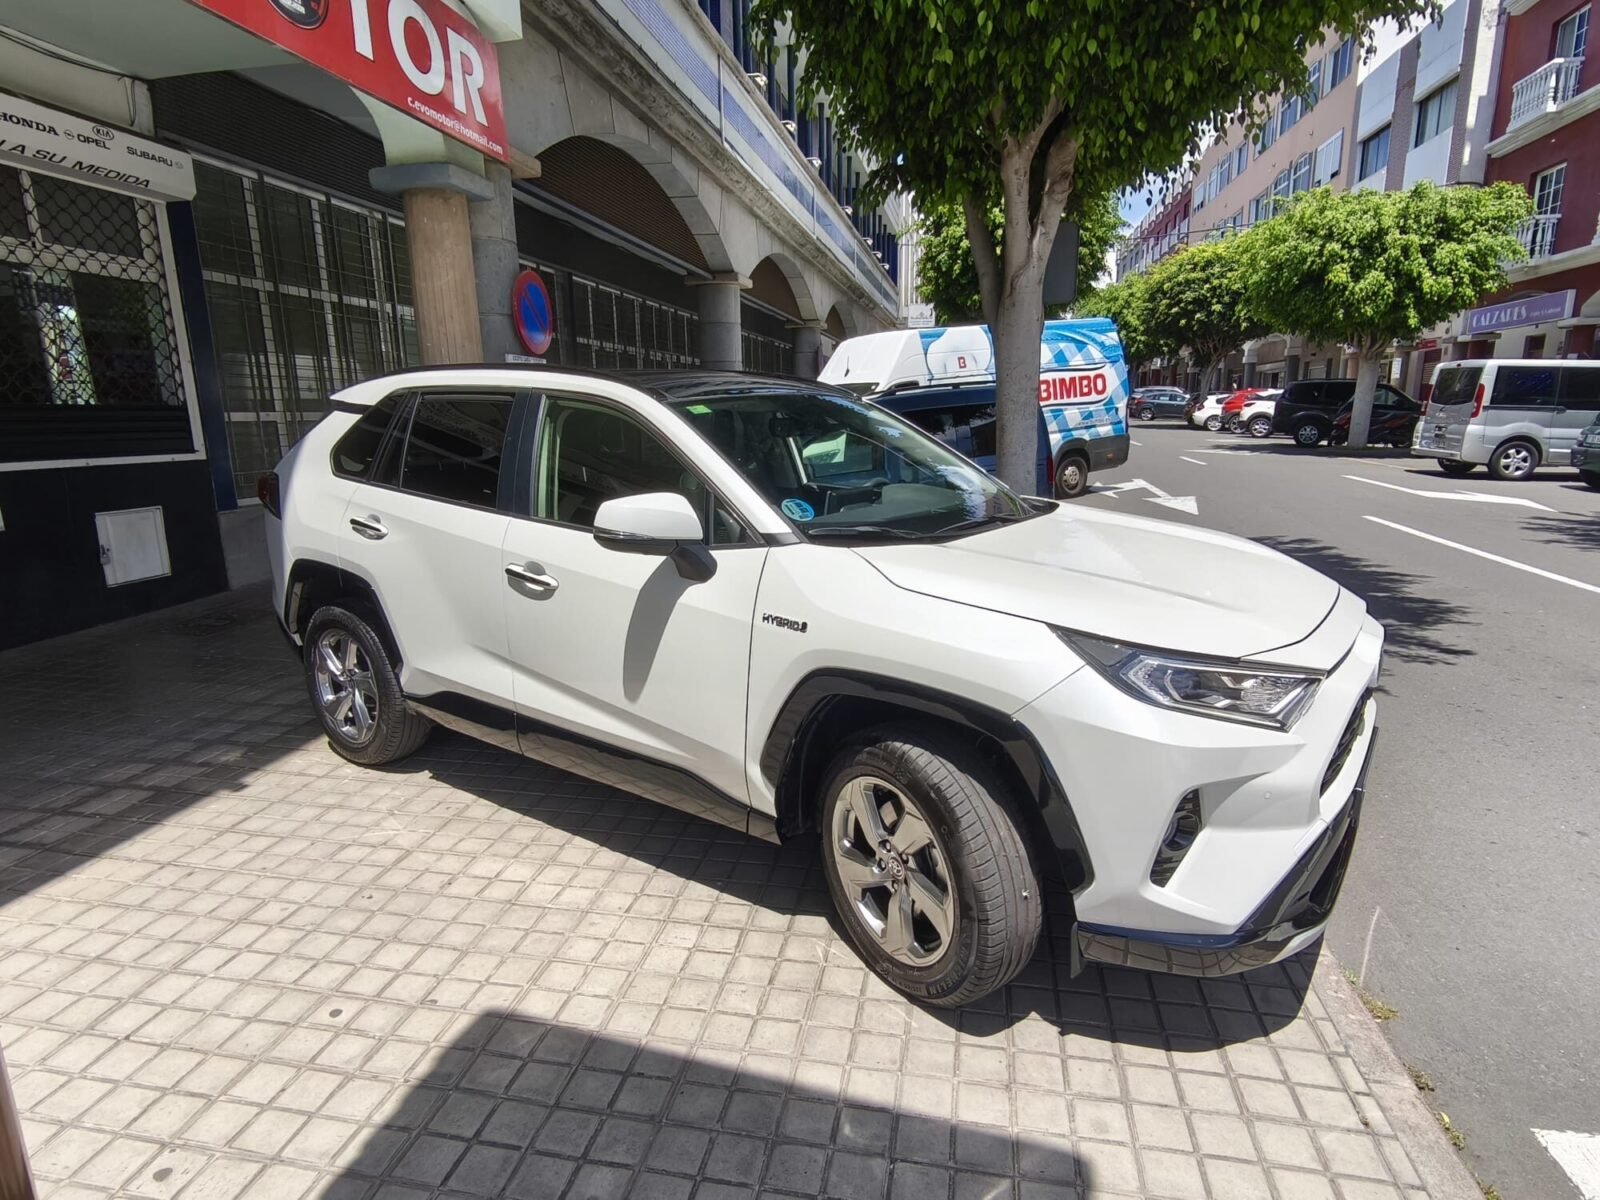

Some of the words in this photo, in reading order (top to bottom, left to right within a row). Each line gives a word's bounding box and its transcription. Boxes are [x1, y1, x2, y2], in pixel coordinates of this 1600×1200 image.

[0, 112, 60, 136] HONDA
[407, 97, 503, 155] c.evomotor@hotmail.com
[77, 134, 111, 150] OPEL
[126, 146, 173, 167] SUBARU
[32, 150, 67, 164] SU
[72, 160, 150, 188] MEDIDA
[957, 356, 967, 369] B
[1039, 373, 1107, 402] BIMBO
